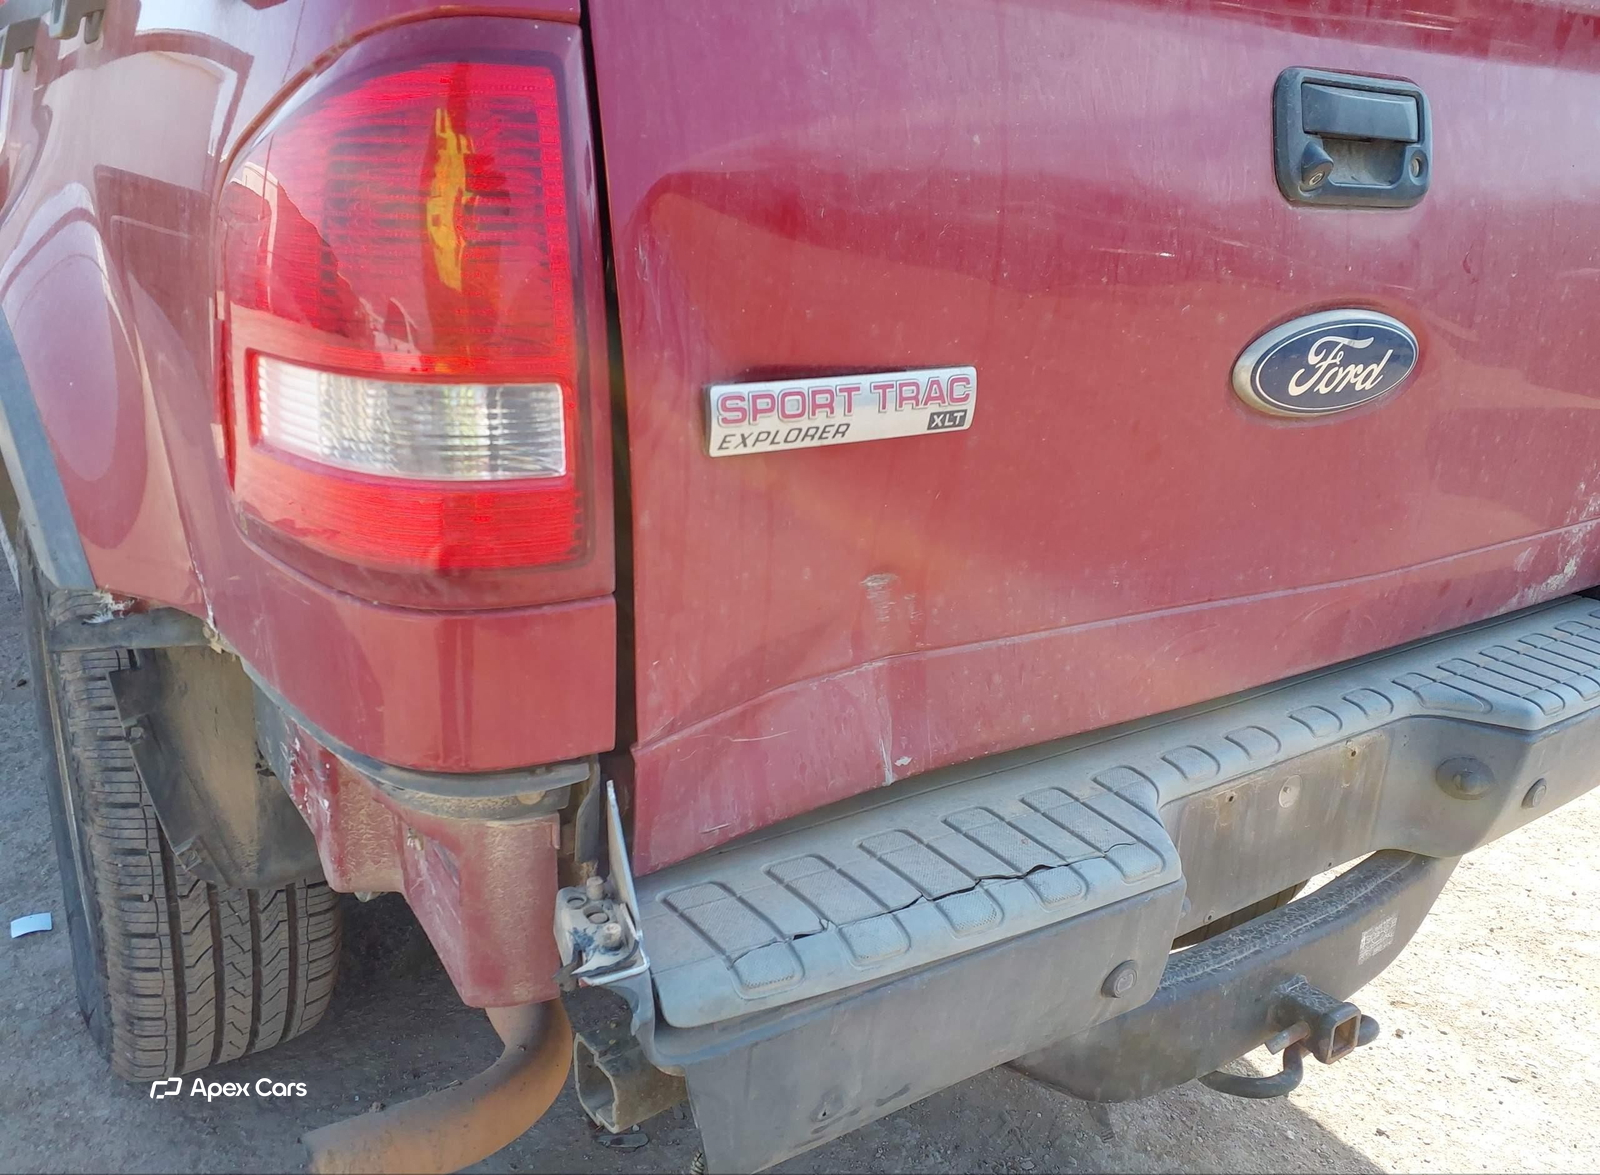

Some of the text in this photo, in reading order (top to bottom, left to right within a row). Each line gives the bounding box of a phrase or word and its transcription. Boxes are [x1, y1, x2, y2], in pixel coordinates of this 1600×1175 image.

[1288, 335, 1394, 396] Ford
[718, 374, 972, 427] SPORT TRAC
[930, 411, 967, 428] XLT
[717, 423, 851, 451] EXPLORER
